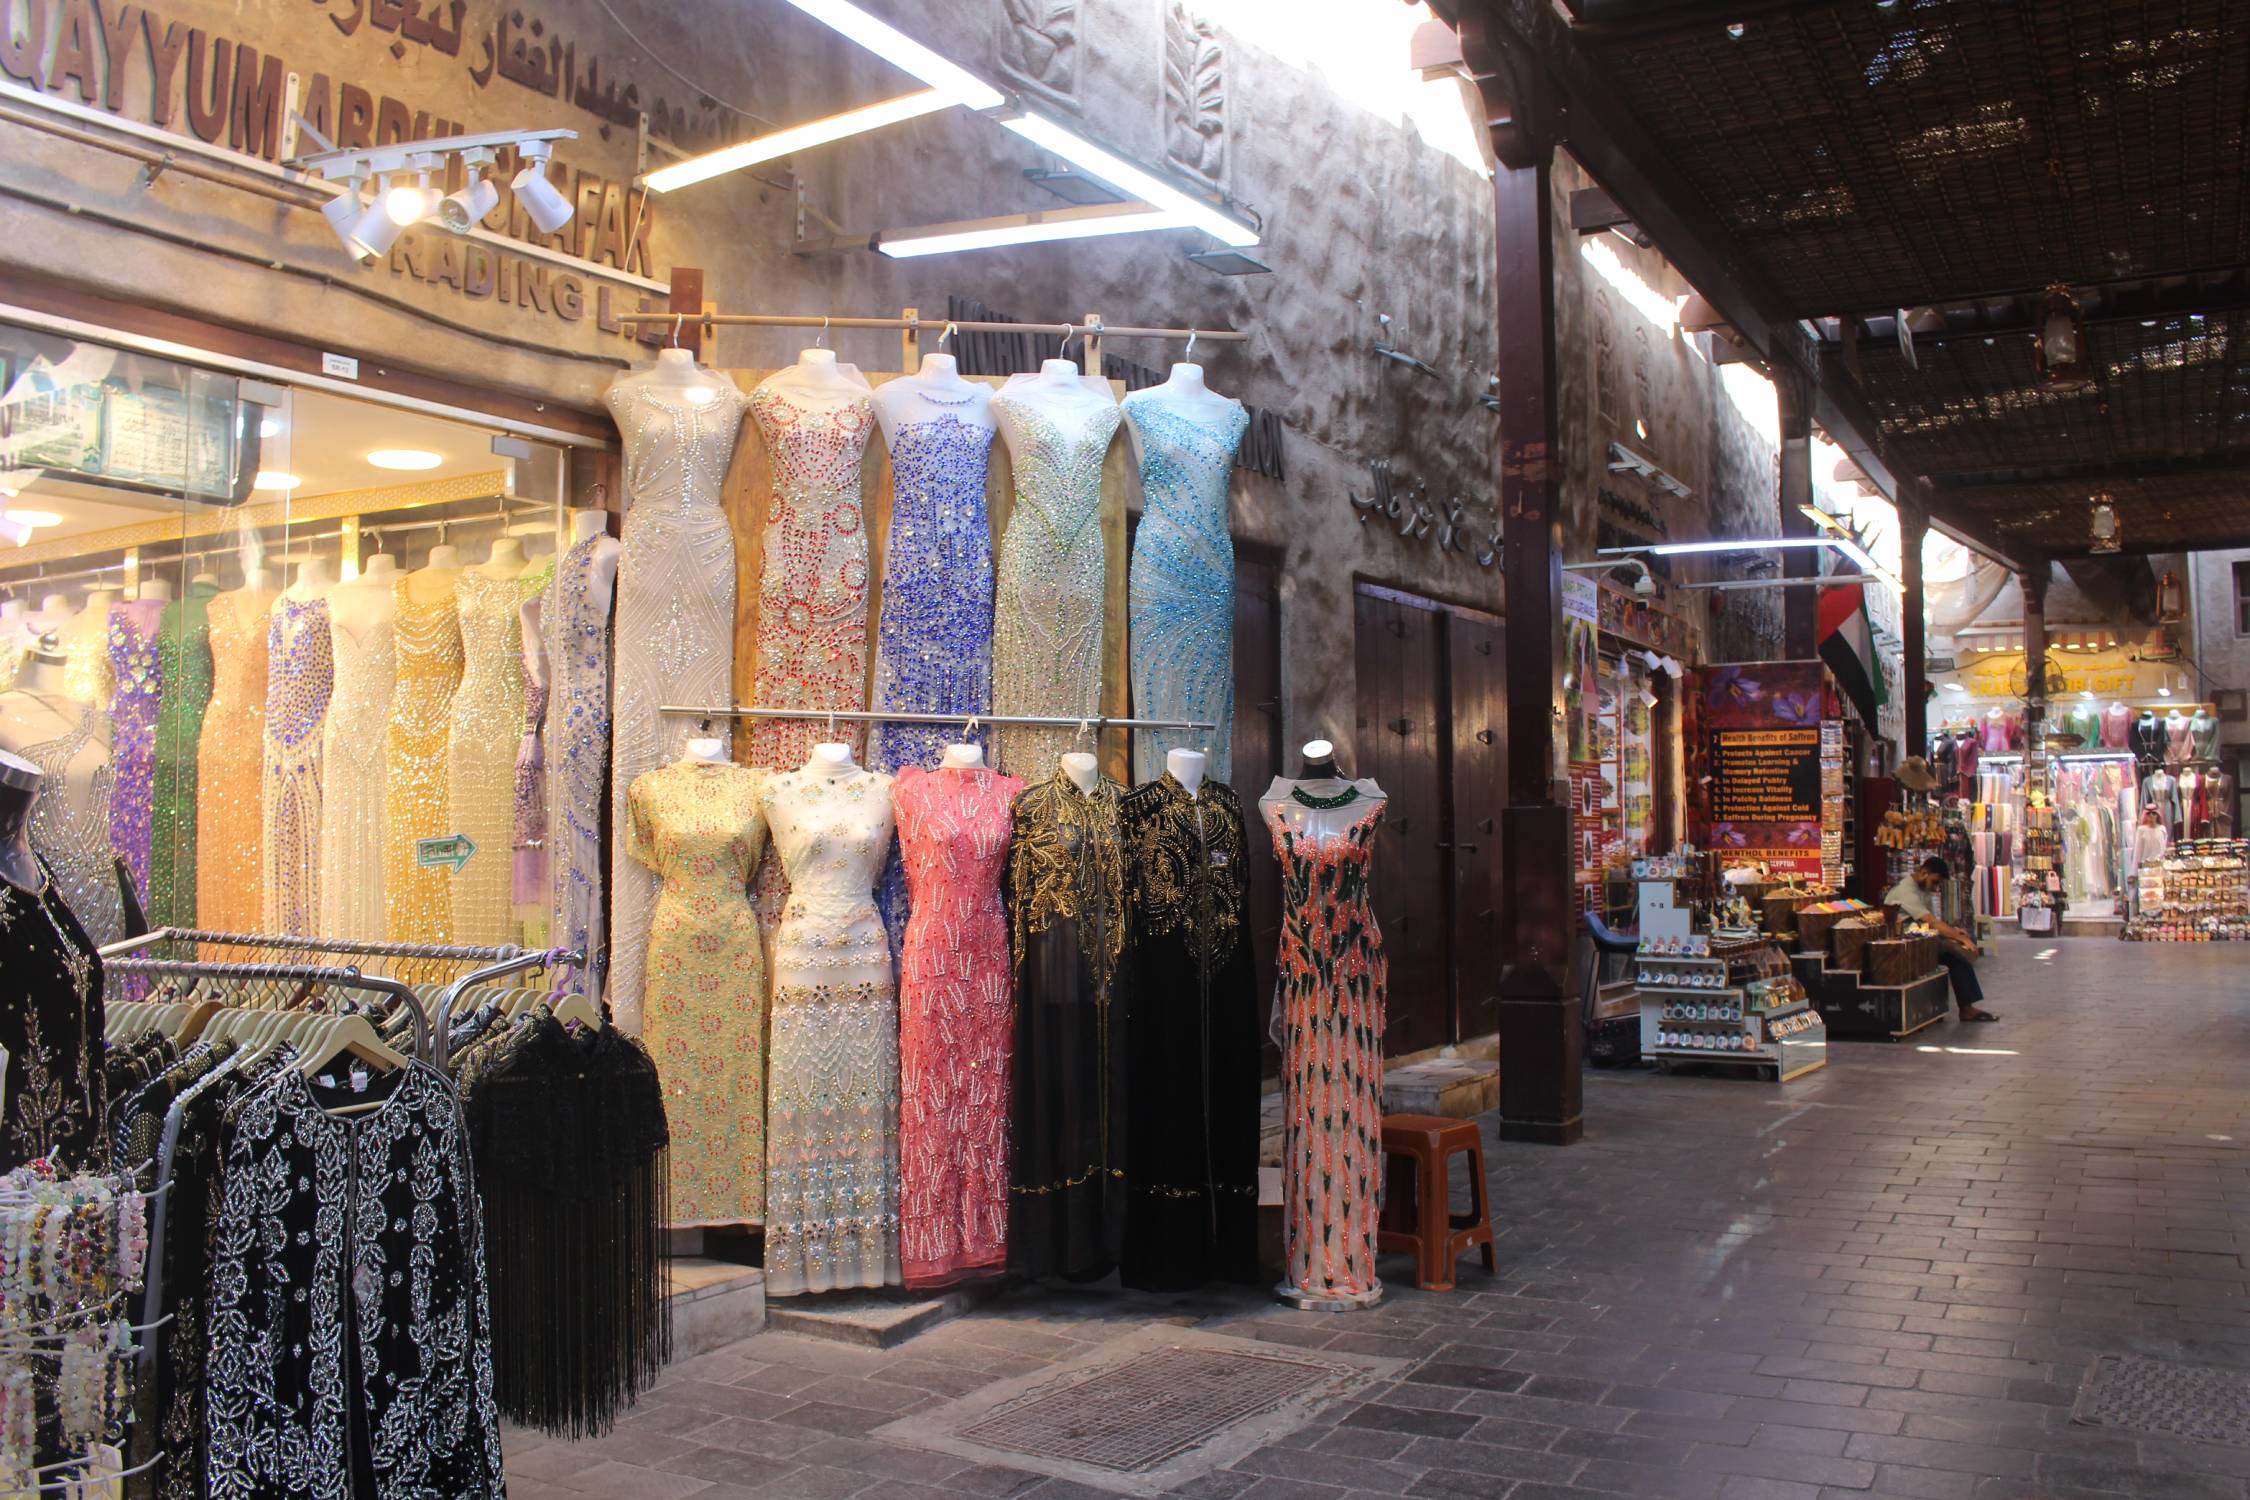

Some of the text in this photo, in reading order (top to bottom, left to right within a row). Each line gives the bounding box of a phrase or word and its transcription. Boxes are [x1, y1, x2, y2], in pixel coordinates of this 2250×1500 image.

[0, 0, 283, 162] QAYYUM
[363, 233, 585, 321] RADING
[1722, 732, 1746, 741] Health
[1748, 731, 1777, 741] Benefits
[1780, 732, 1787, 741] of
[1789, 731, 1816, 741] Saffron
[1755, 749, 1782, 758] Against
[1763, 805, 1790, 813] Against
[1751, 814, 1776, 822] During
[1778, 813, 1817, 822] Pregnancy
[1721, 849, 1809, 857] MENTHOL BENEFITS
